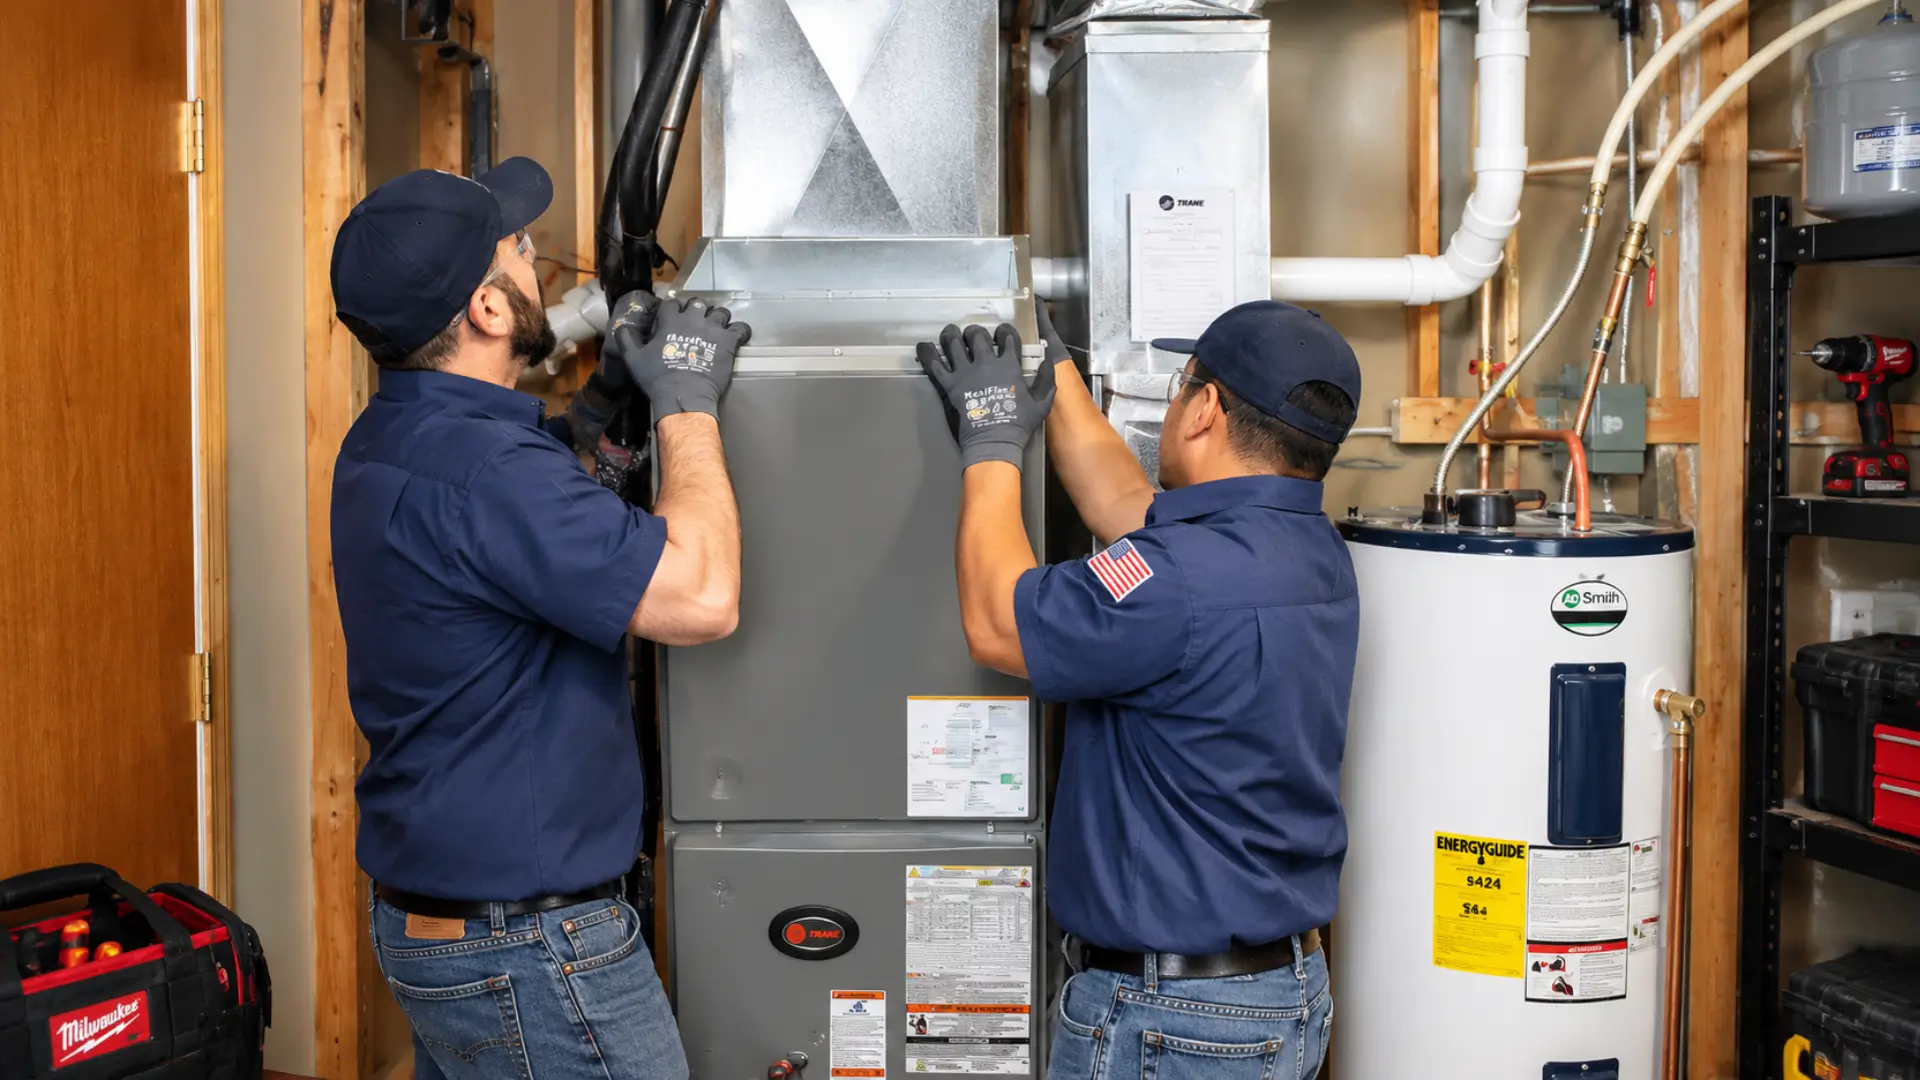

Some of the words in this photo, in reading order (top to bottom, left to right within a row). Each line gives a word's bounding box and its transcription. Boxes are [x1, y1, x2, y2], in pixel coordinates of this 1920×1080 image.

[1583, 591, 1620, 604] Smith
[1437, 836, 1525, 859] ENERGYGUIDE
[56, 998, 140, 1051] Milwaukee
